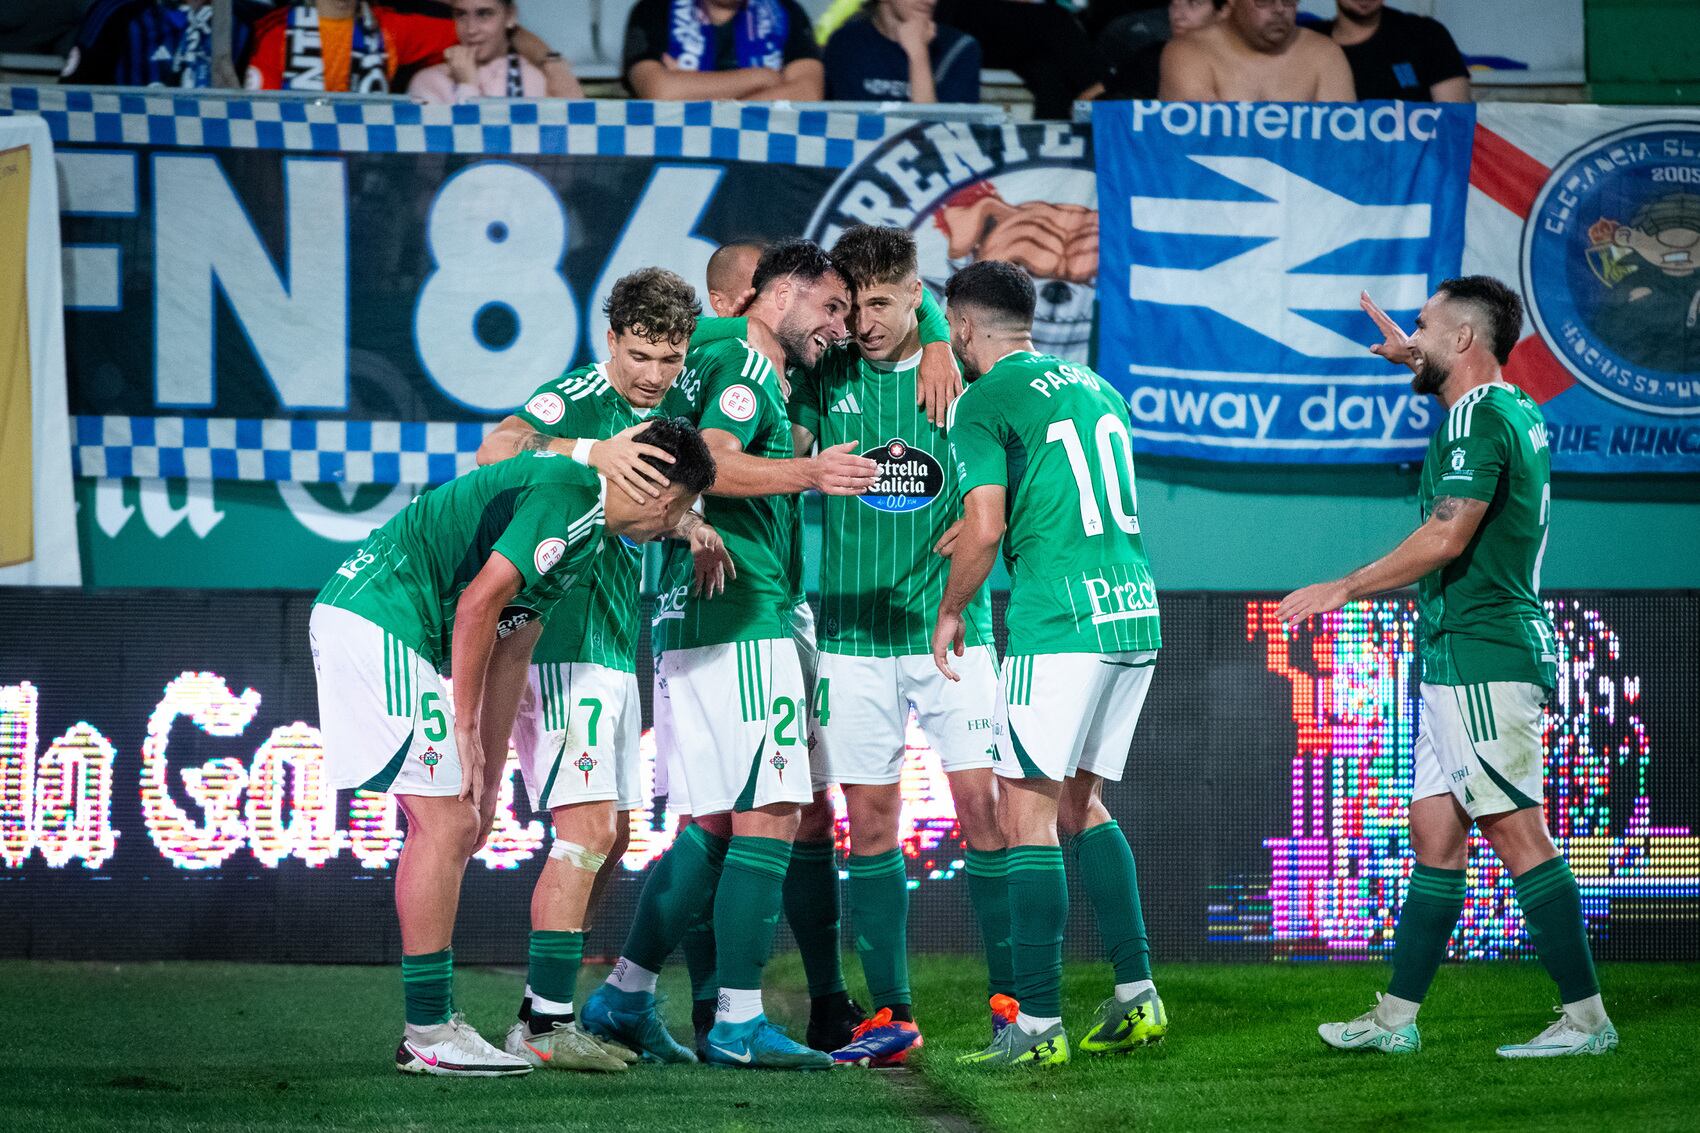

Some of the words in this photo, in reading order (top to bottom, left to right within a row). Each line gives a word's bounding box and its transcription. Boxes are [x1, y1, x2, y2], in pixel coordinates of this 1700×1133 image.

[1131, 385, 1281, 440] away
[1299, 385, 1431, 440] days
[874, 459, 928, 476] strella
[1045, 413, 1141, 537] 10
[421, 691, 448, 743] 5
[578, 697, 603, 747] 7
